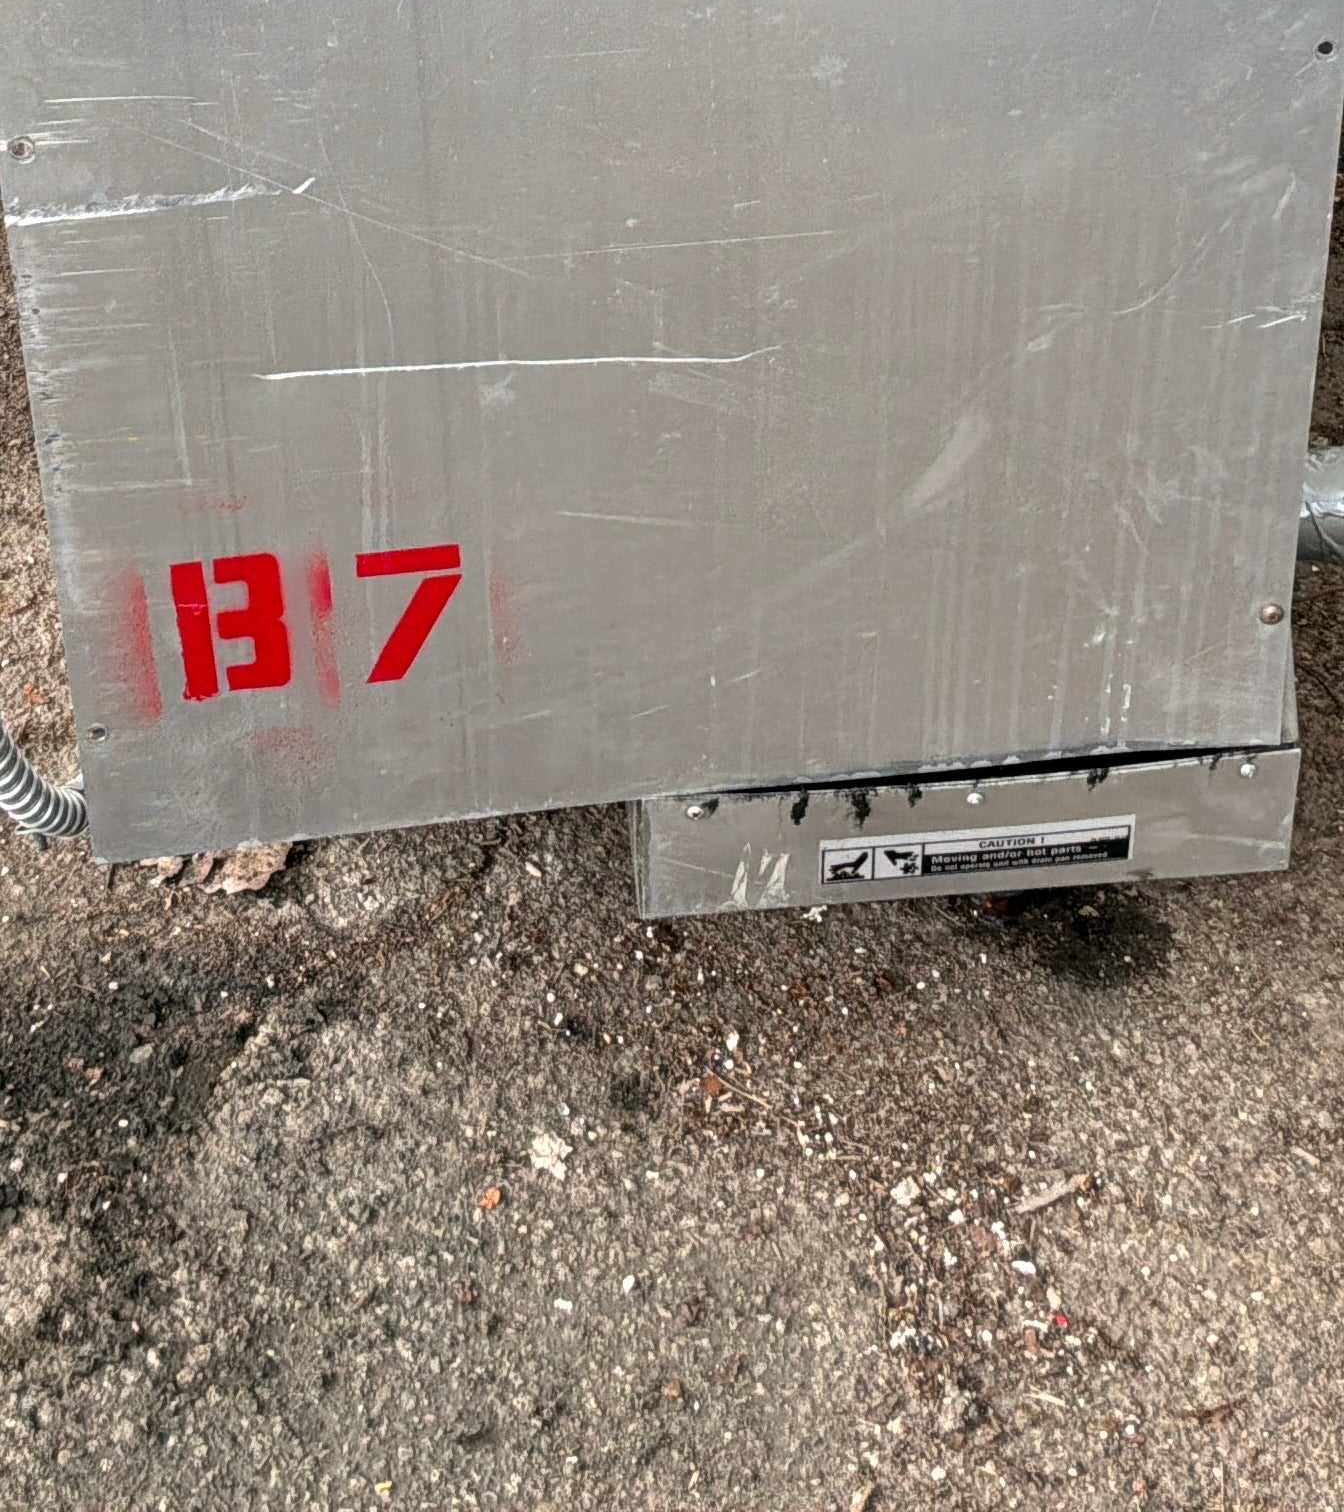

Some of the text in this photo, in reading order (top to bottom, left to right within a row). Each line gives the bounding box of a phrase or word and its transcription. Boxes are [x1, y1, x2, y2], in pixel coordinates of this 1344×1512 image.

[979, 837, 1035, 849] CAUTION
[931, 854, 977, 864] Moving
[982, 850, 1022, 861] and/or
[1027, 849, 1046, 857] hot
[1051, 846, 1081, 855] parts
